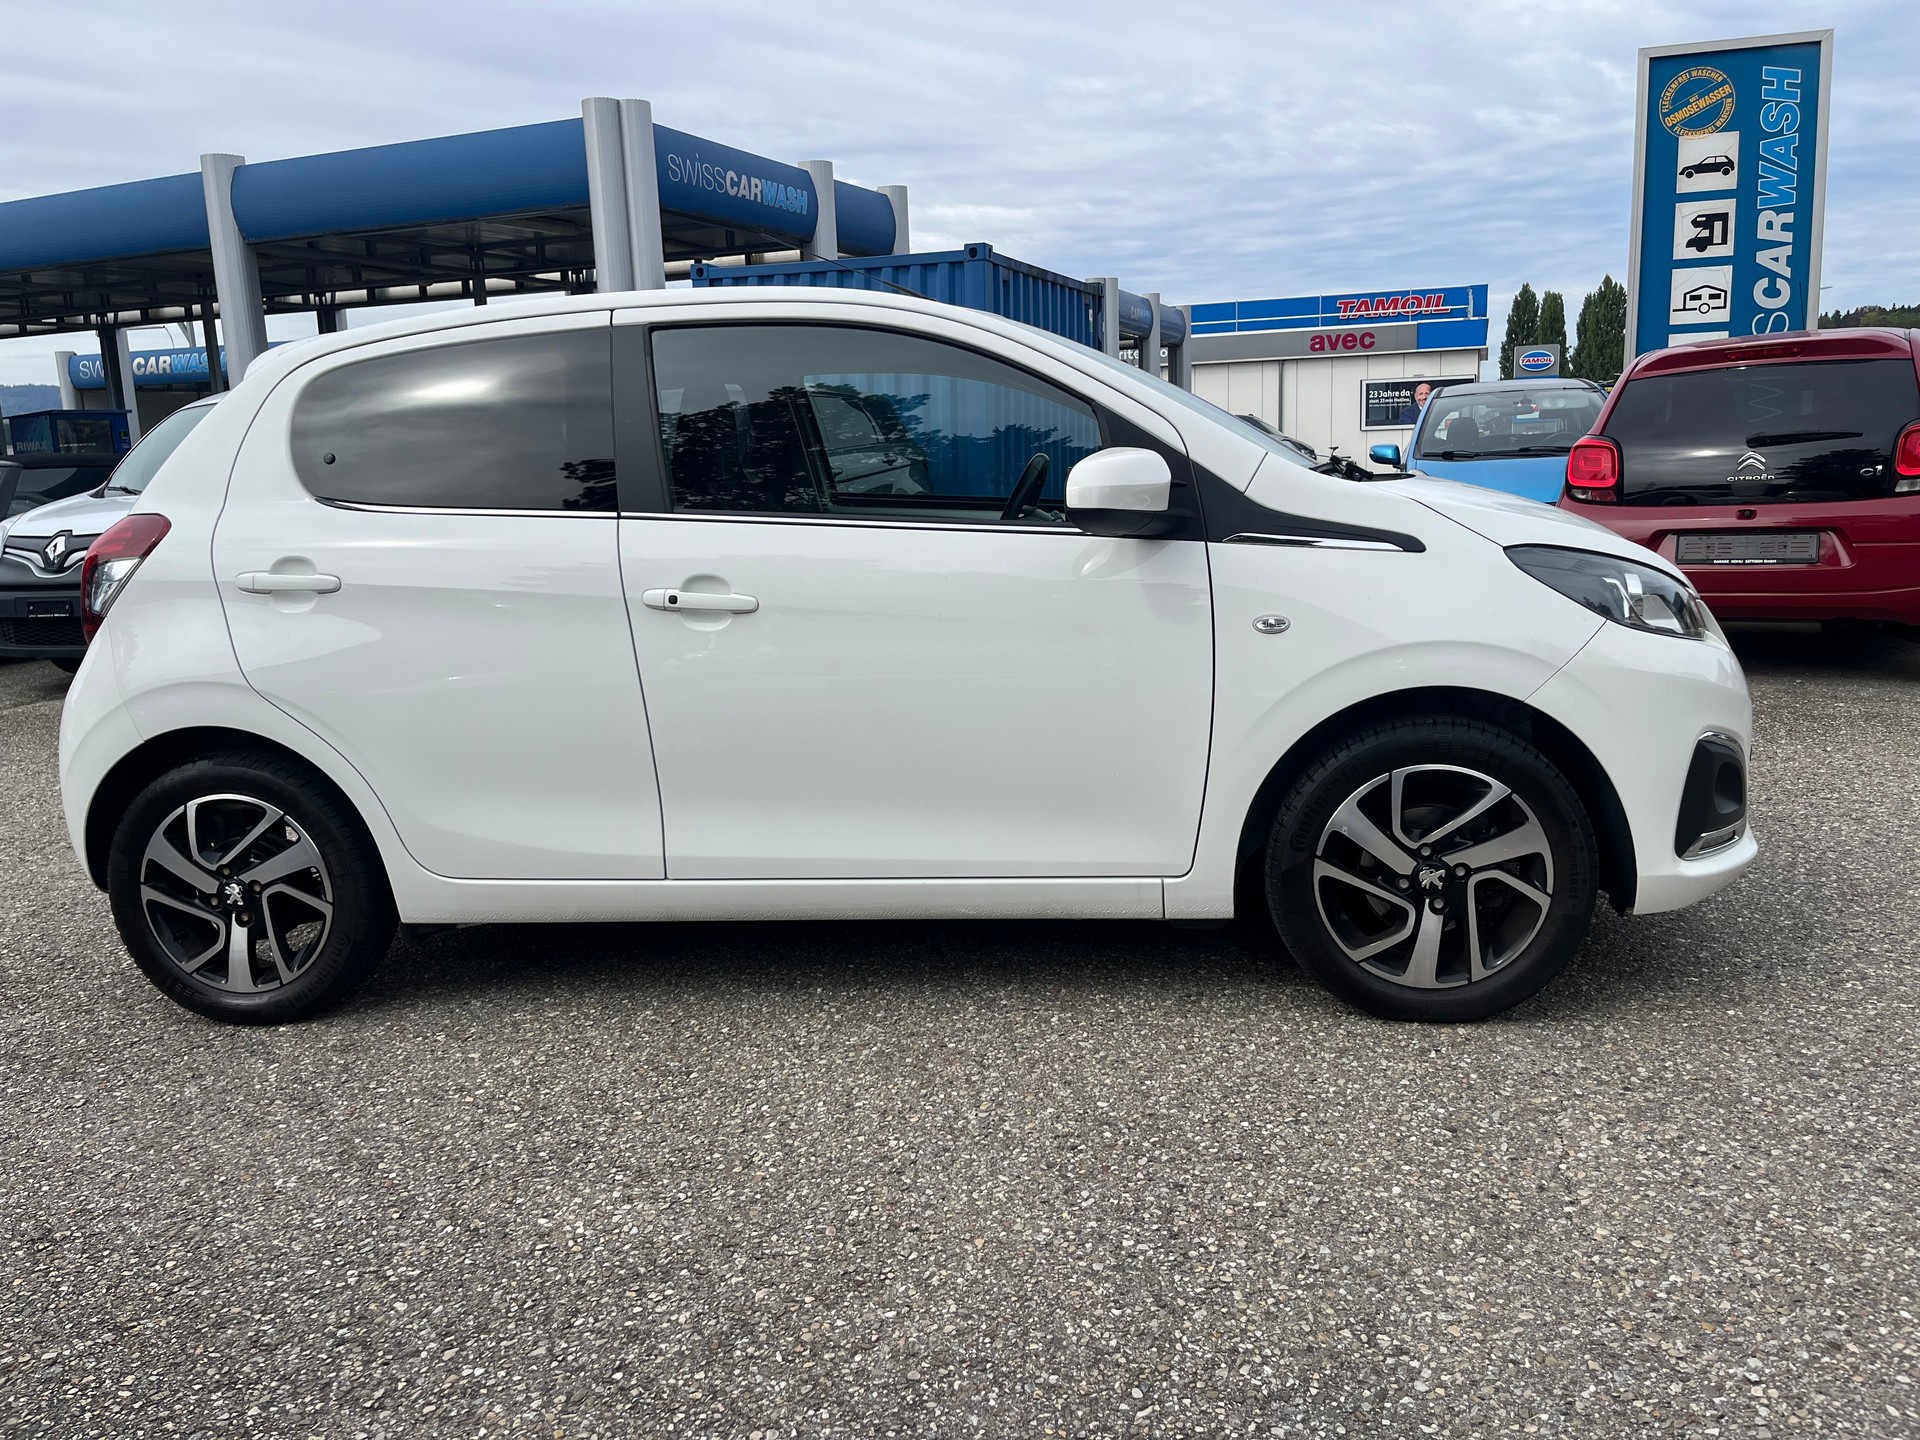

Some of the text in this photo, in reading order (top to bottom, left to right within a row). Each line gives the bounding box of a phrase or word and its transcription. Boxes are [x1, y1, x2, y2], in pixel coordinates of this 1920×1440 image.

[1662, 69, 1724, 112] FLECKENFREI WASCHEN
[1665, 84, 1732, 127] OSMOSEWASSER
[1336, 294, 1451, 319] TAMOIL
[1309, 332, 1375, 352] avec
[1369, 390, 1378, 398] 23
[1379, 390, 1399, 398] Jahre
[1400, 389, 1410, 397] da
[16, 441, 48, 452] RIWAX
[1859, 465, 1883, 477] C1
